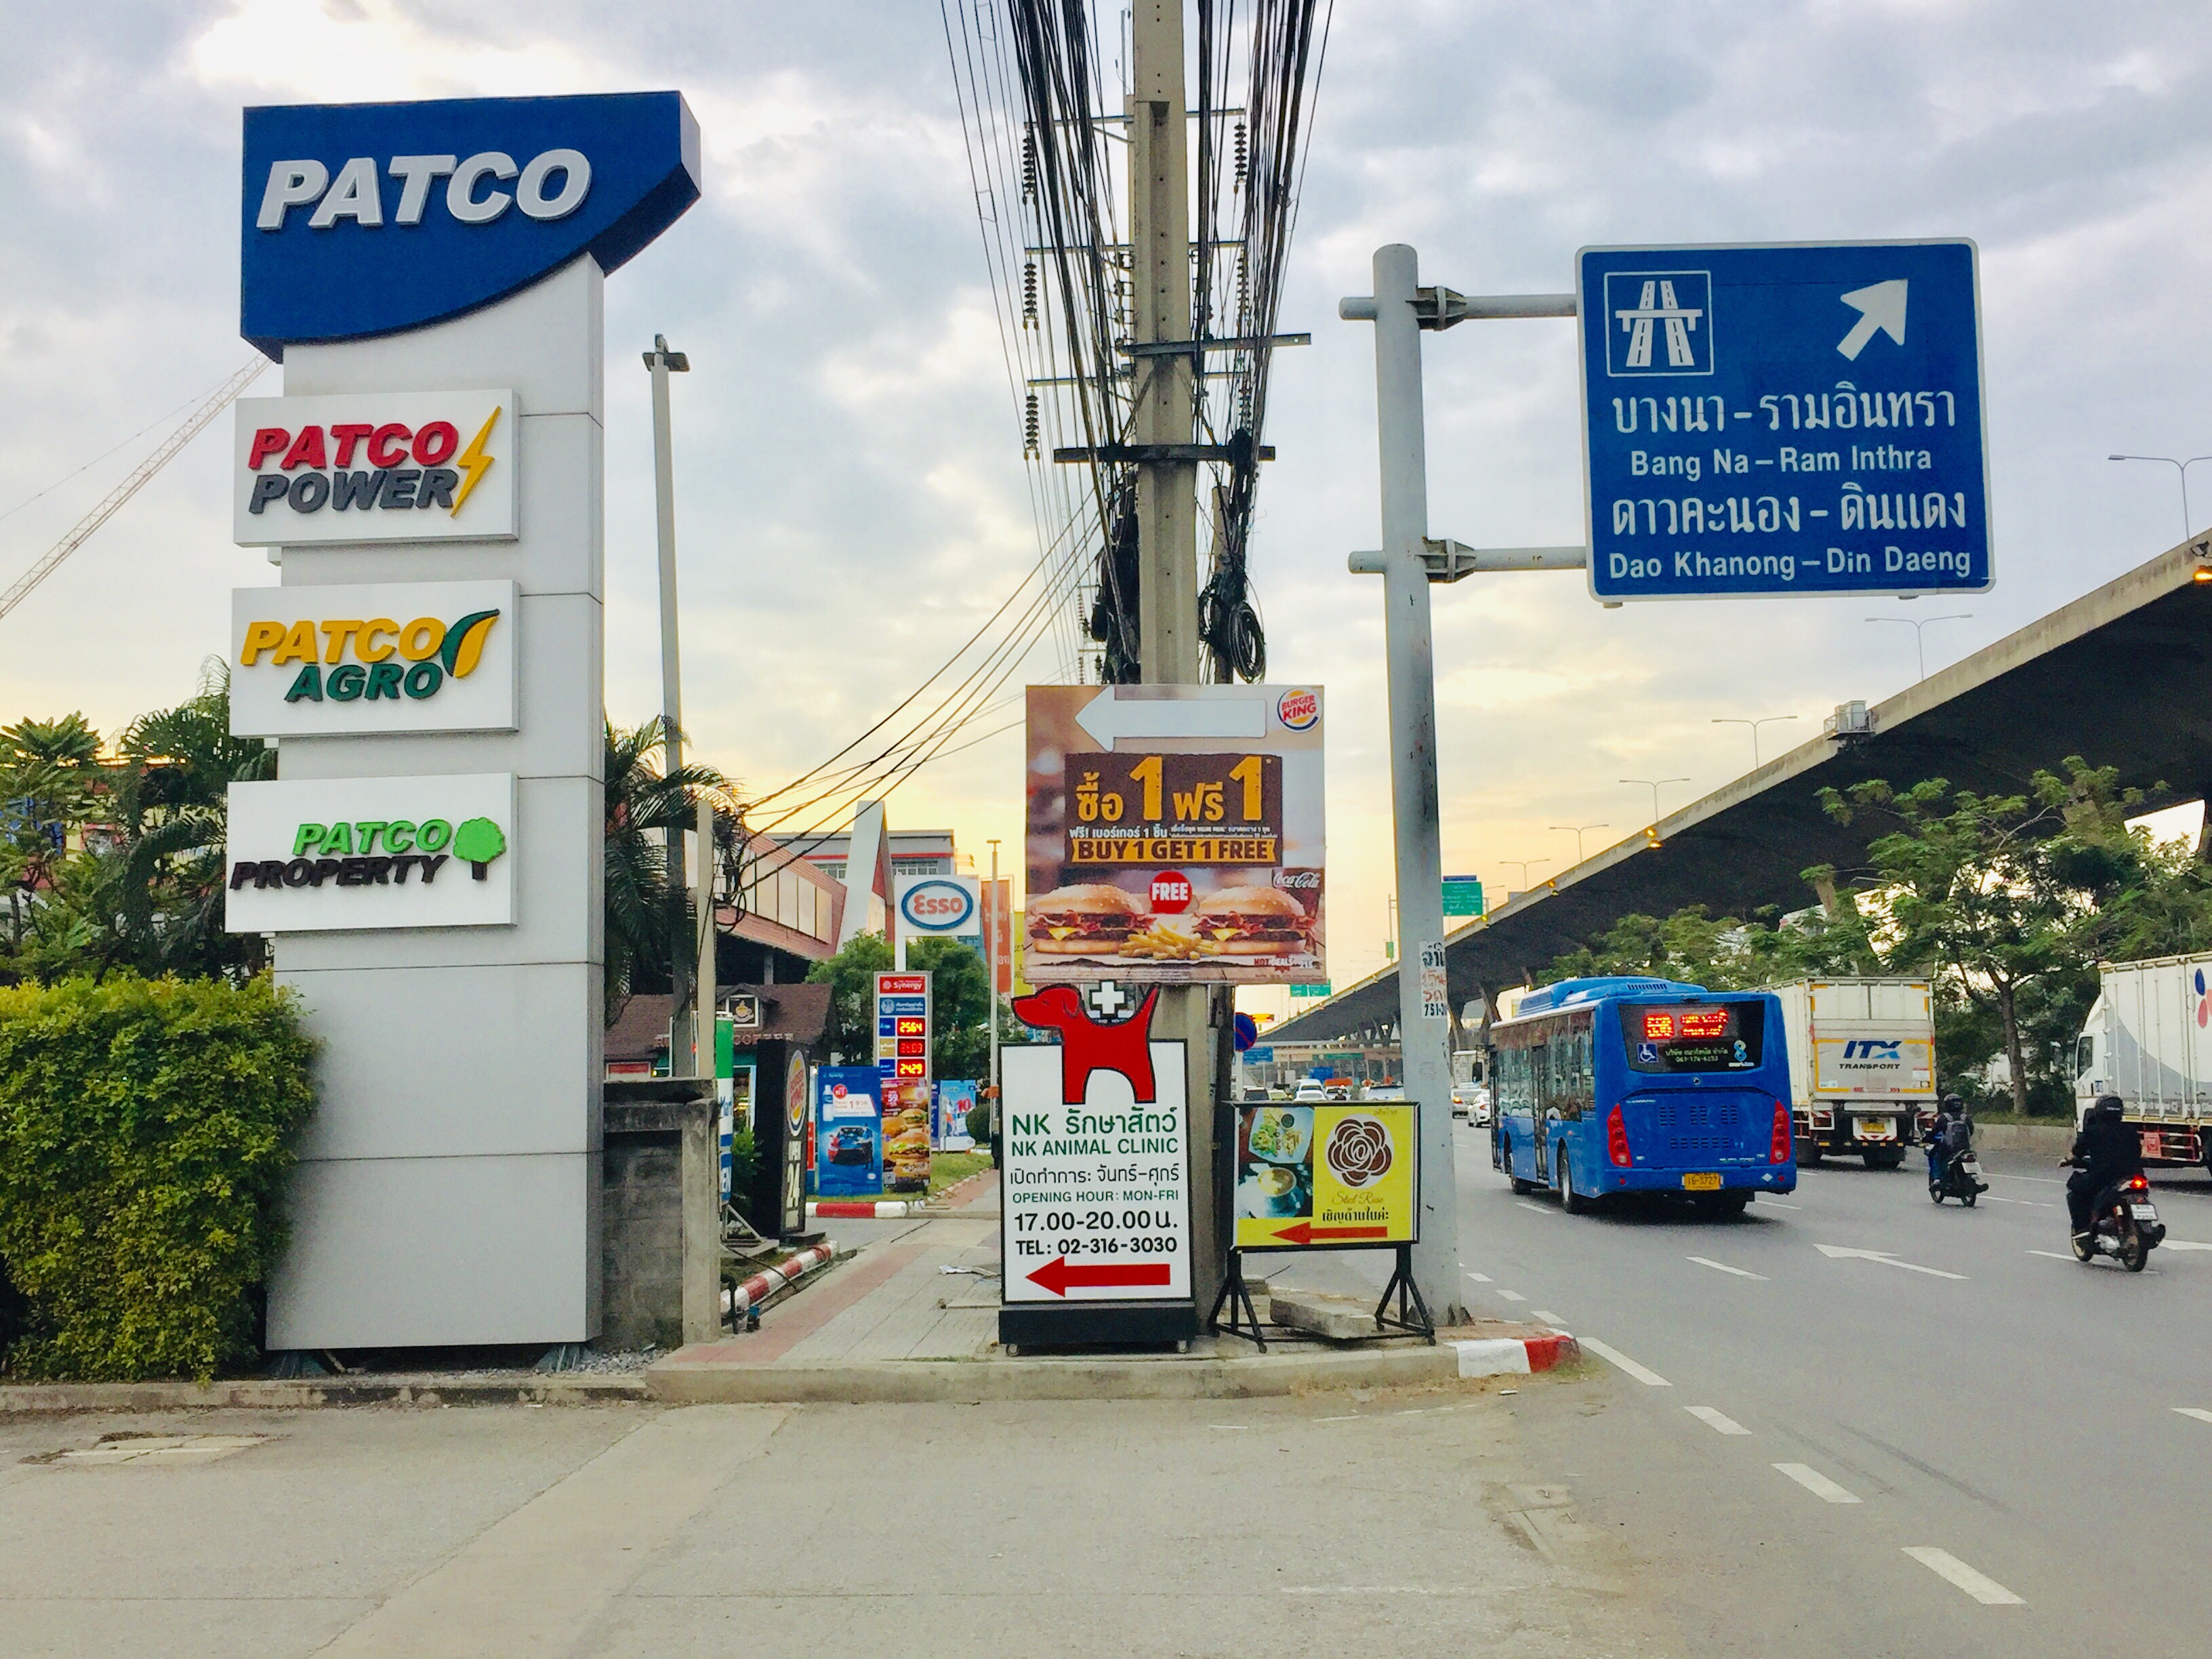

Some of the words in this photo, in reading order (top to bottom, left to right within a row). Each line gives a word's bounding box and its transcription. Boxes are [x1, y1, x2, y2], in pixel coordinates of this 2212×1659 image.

[256, 149, 592, 230] PATCO
[249, 420, 459, 470] PATCO
[1631, 450, 1701, 481] Bang
[1853, 445, 1931, 471] Inthra
[249, 468, 459, 515] POWER
[1610, 552, 1662, 578] Dao
[1886, 547, 1971, 578] Daeng
[241, 617, 447, 665] PATCO
[284, 663, 443, 701] AGRO
[1282, 695, 1315, 710] BURGER
[1283, 703, 1316, 722] KING
[1076, 771, 1124, 821] ซื้อ
[1129, 756, 1164, 821] 1
[1172, 781, 1225, 821] ฟรี
[292, 819, 453, 855] PATCO
[1092, 826, 1141, 838] เบอร์เกอร์
[1143, 828, 1149, 838] 1
[1078, 841, 1128, 859] BUY
[1132, 842, 1144, 859] 1
[1151, 841, 1196, 859] GET
[1200, 841, 1212, 859] 1
[1219, 840, 1268, 859] FREE
[229, 855, 449, 890] PROPERTY
[914, 893, 963, 916] Esso
[1152, 882, 1189, 901] FREE
[893, 981, 922, 991] Synergy
[1843, 1041, 1902, 1059] ITX
[1012, 1113, 1050, 1135] NK
[1065, 1106, 1177, 1134] รักษาสัตว์
[1012, 1141, 1037, 1156] NK
[1042, 1139, 1111, 1155] ANIMAL
[1118, 1138, 1179, 1153] CLINIC
[787, 1162, 800, 1208] 24
[1012, 1191, 1071, 1204] OPENING
[1123, 1190, 1179, 1201] MON-FRI
[1015, 1210, 1151, 1231] 17.00-20.00
[1016, 1240, 1051, 1255] TEL:
[1058, 1237, 1177, 1254] 02-316-3030
